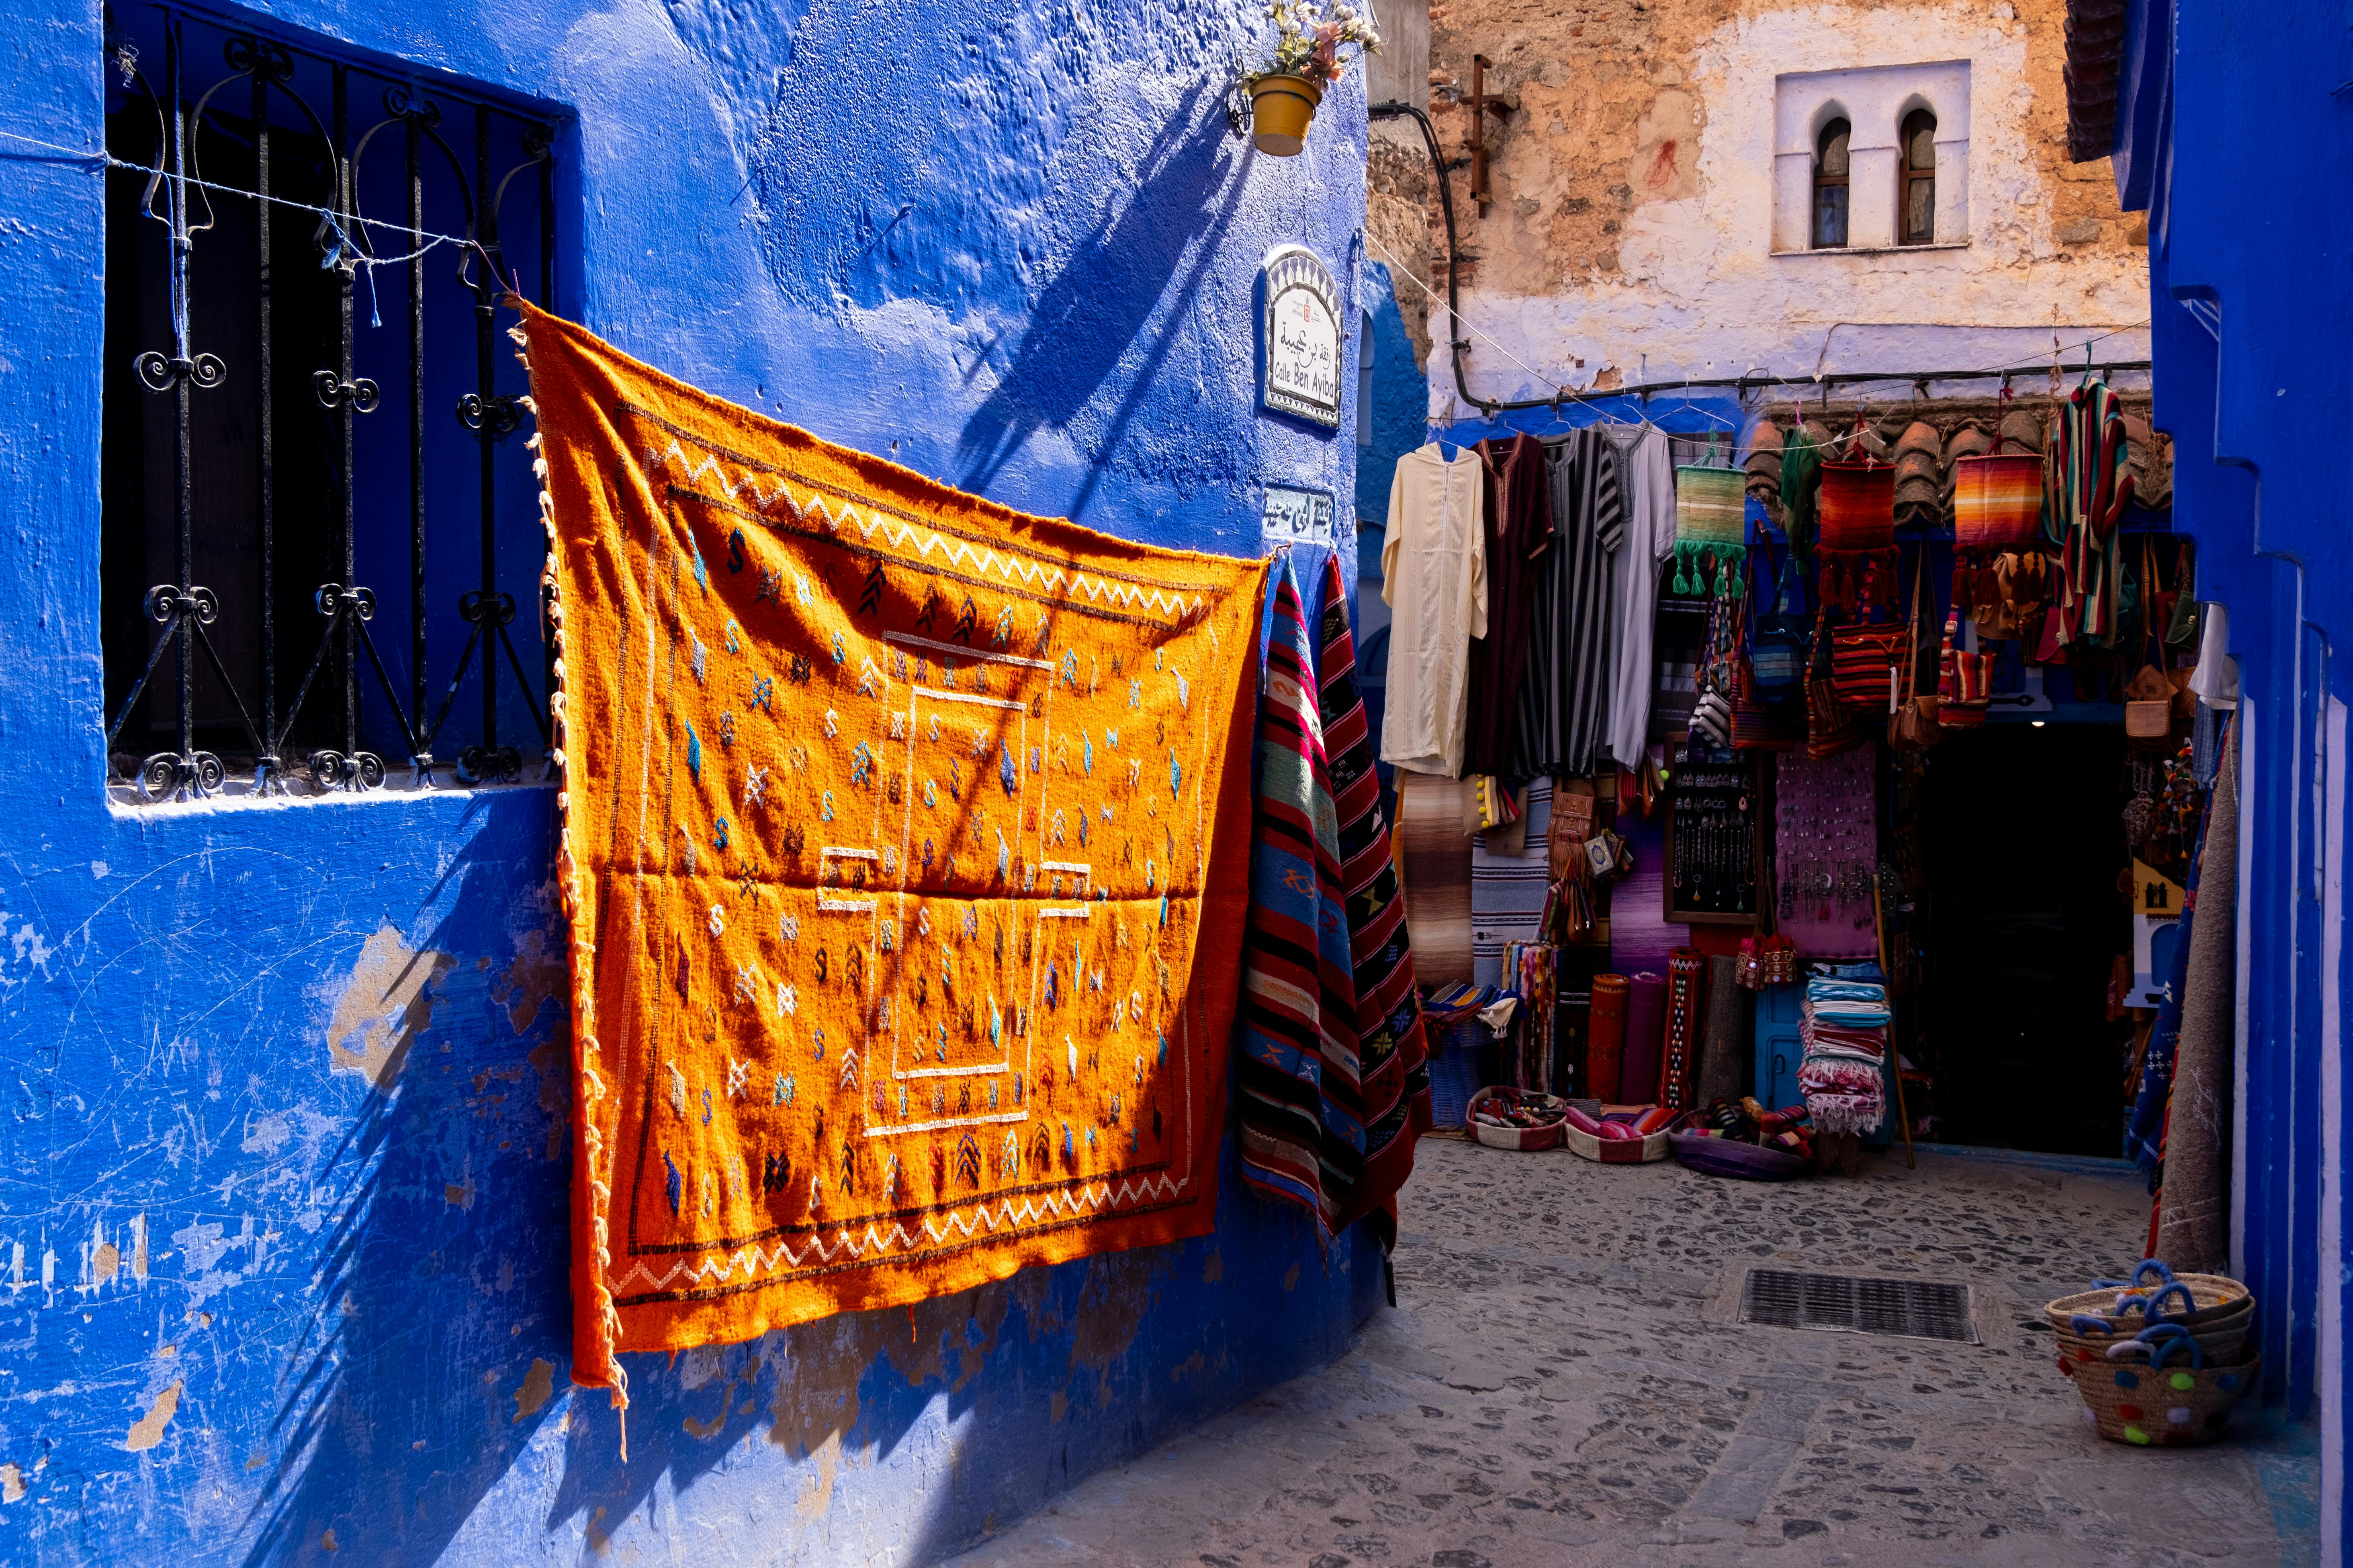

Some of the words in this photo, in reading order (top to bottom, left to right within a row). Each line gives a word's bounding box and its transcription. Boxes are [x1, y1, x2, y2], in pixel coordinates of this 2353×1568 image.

[1281, 321, 1307, 354] عجيبة
[1297, 343, 1317, 368] بن
[1320, 344, 1330, 370] زنقة
[1275, 362, 1290, 382] Calle
[1294, 362, 1308, 390] Ben
[1312, 371, 1334, 401] Ayiba
